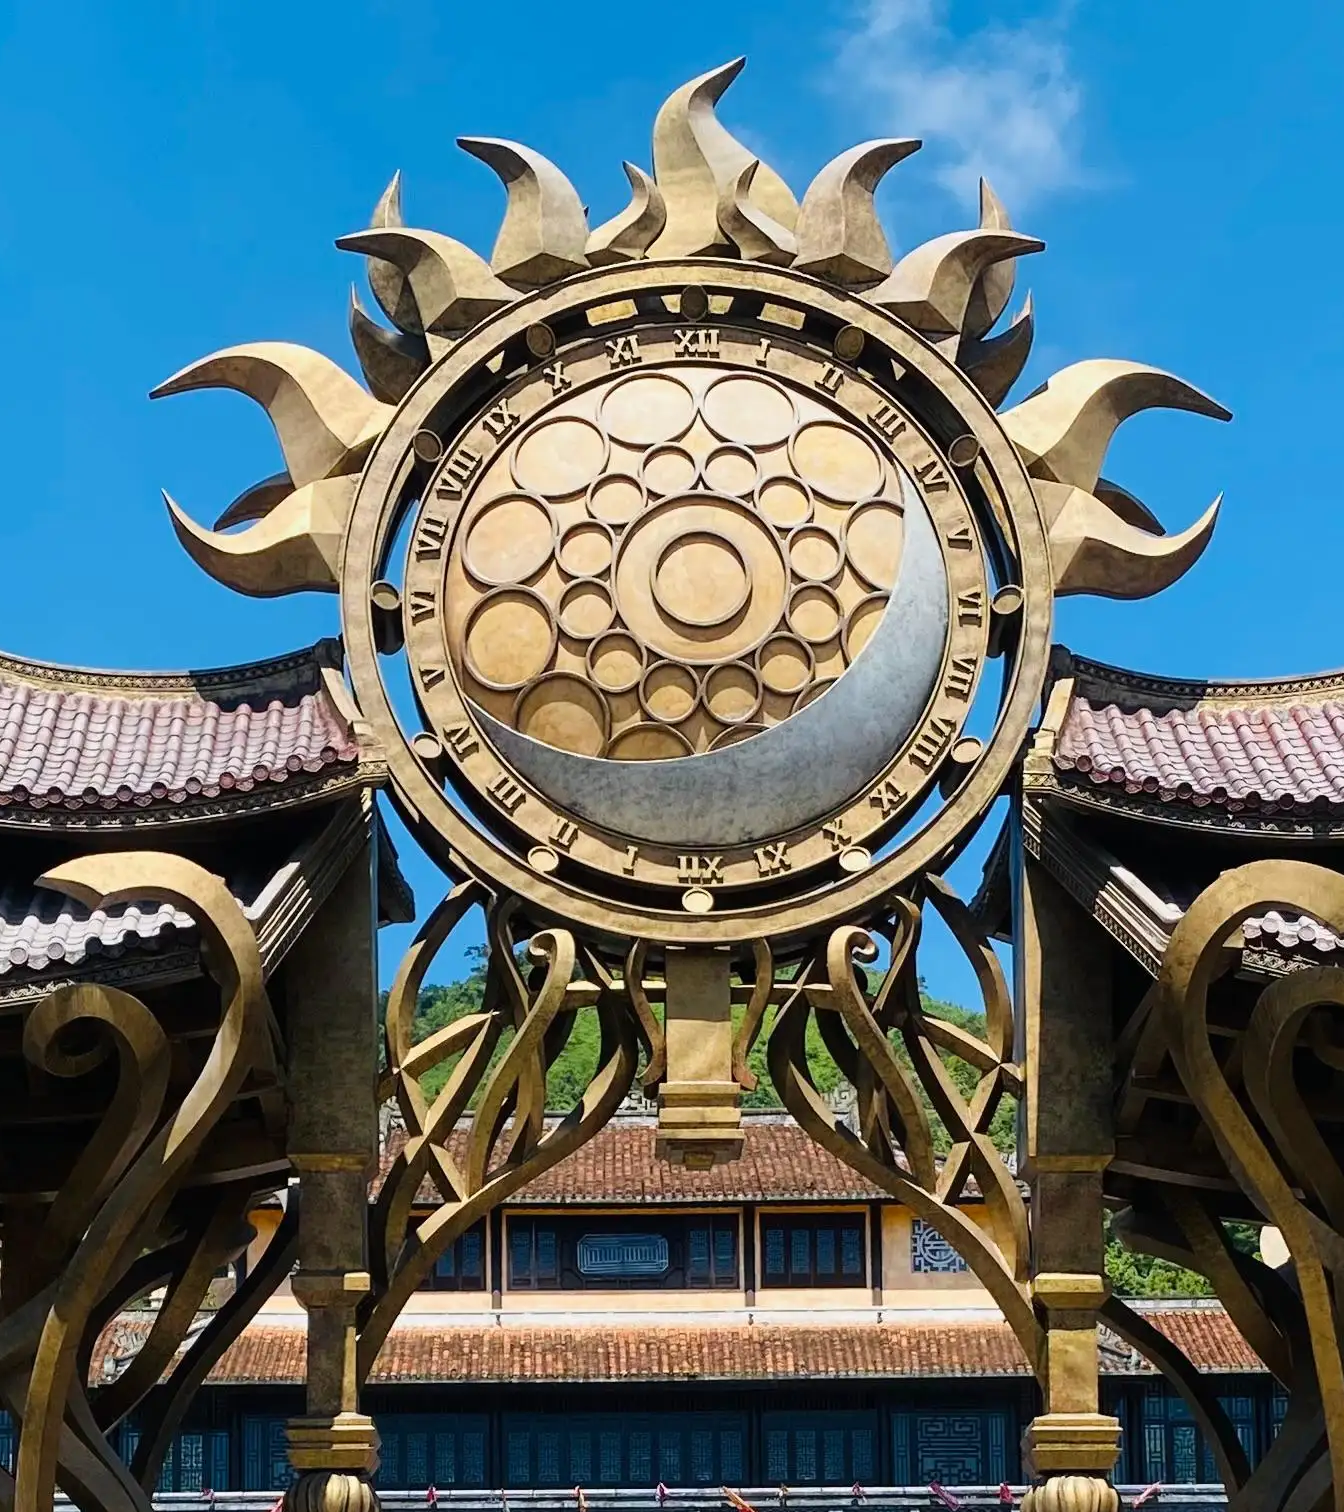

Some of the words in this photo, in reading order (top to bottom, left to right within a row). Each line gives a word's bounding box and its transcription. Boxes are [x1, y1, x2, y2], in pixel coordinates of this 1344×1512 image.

[674, 329, 719, 358] XII
[756, 338, 771, 366] I
[544, 361, 571, 391] X
[815, 361, 846, 396] II
[867, 400, 907, 444] III
[437, 449, 482, 499] VIII
[416, 511, 449, 560] VII
[957, 588, 983, 627] VI
[945, 654, 978, 703] VII
[486, 772, 527, 816] III
[548, 818, 579, 853] II
[822, 819, 852, 850] X
[622, 846, 639, 876] I
